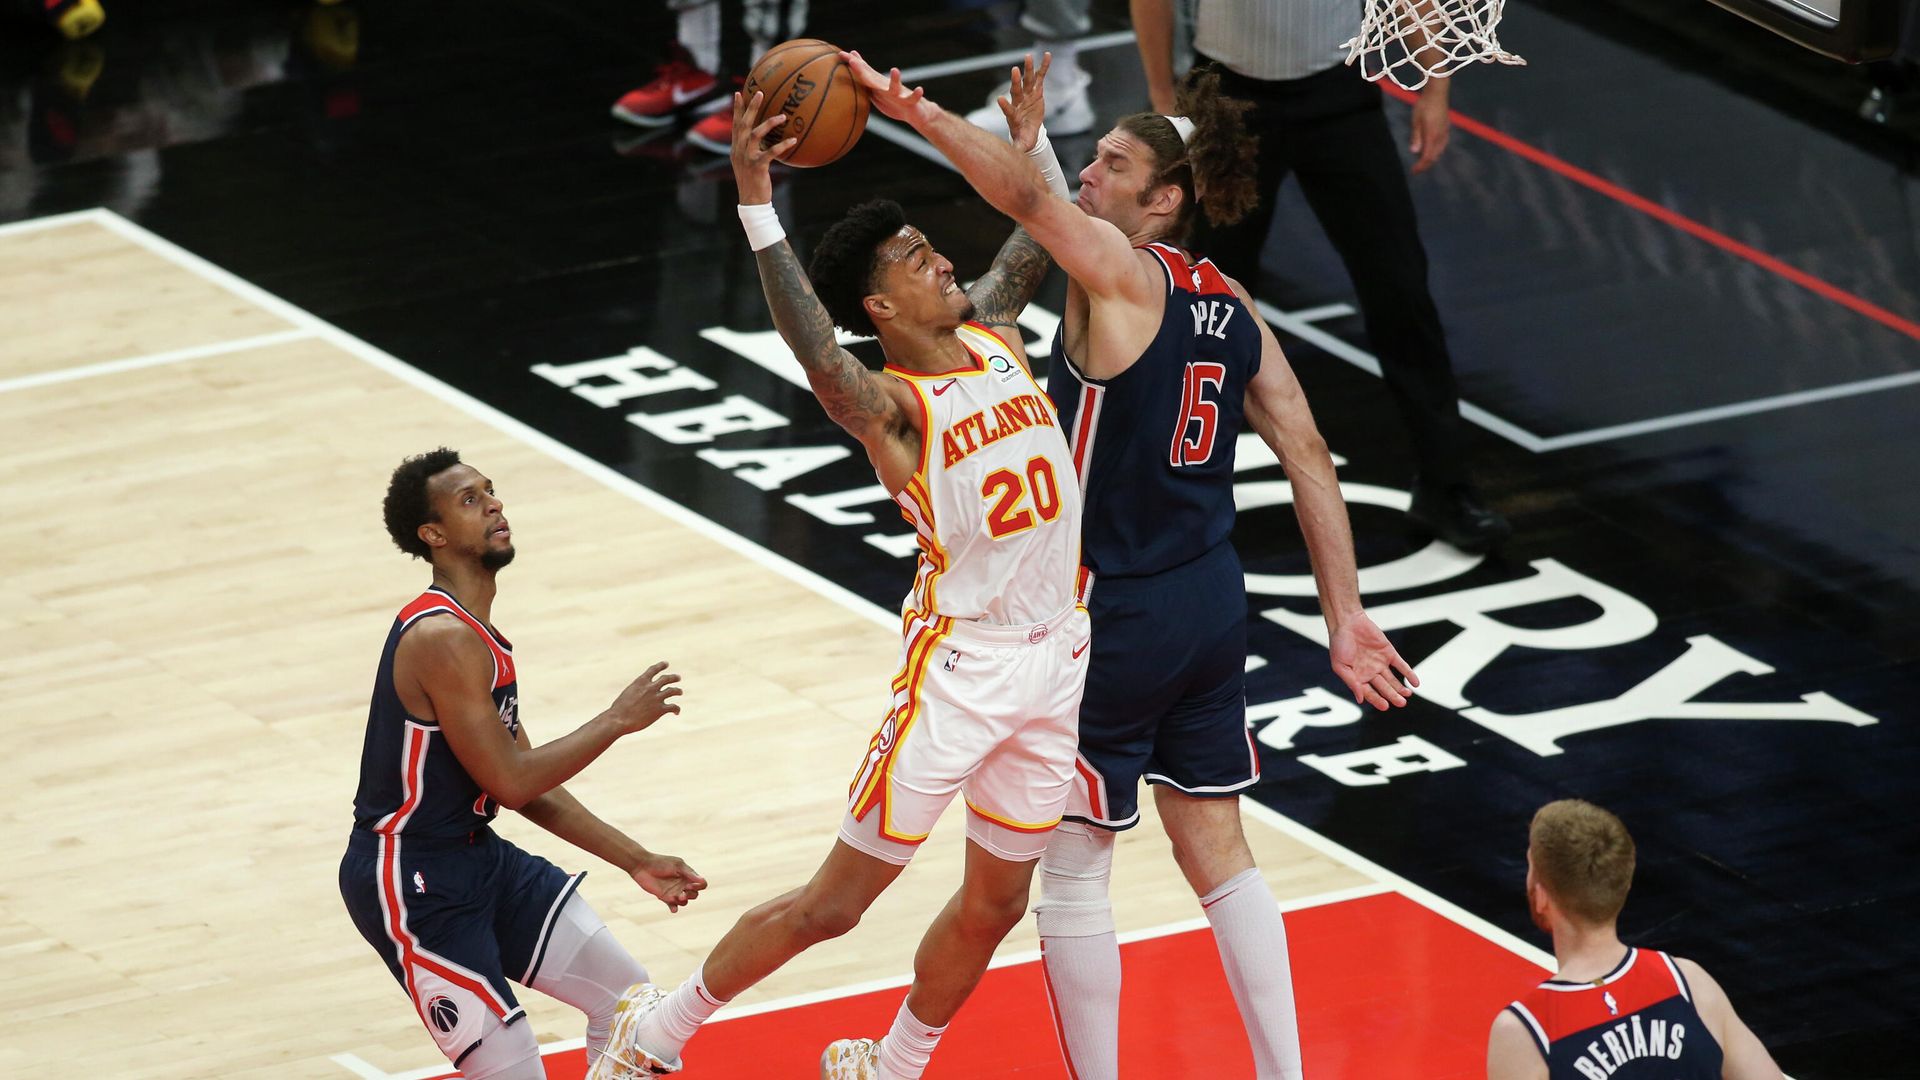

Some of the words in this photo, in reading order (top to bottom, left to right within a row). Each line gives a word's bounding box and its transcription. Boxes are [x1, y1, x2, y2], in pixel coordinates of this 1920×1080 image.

[1190, 300, 1235, 340] PEZ
[942, 394, 1054, 472] ATLANTA
[1169, 362, 1227, 467] 15
[981, 454, 1063, 540] 20
